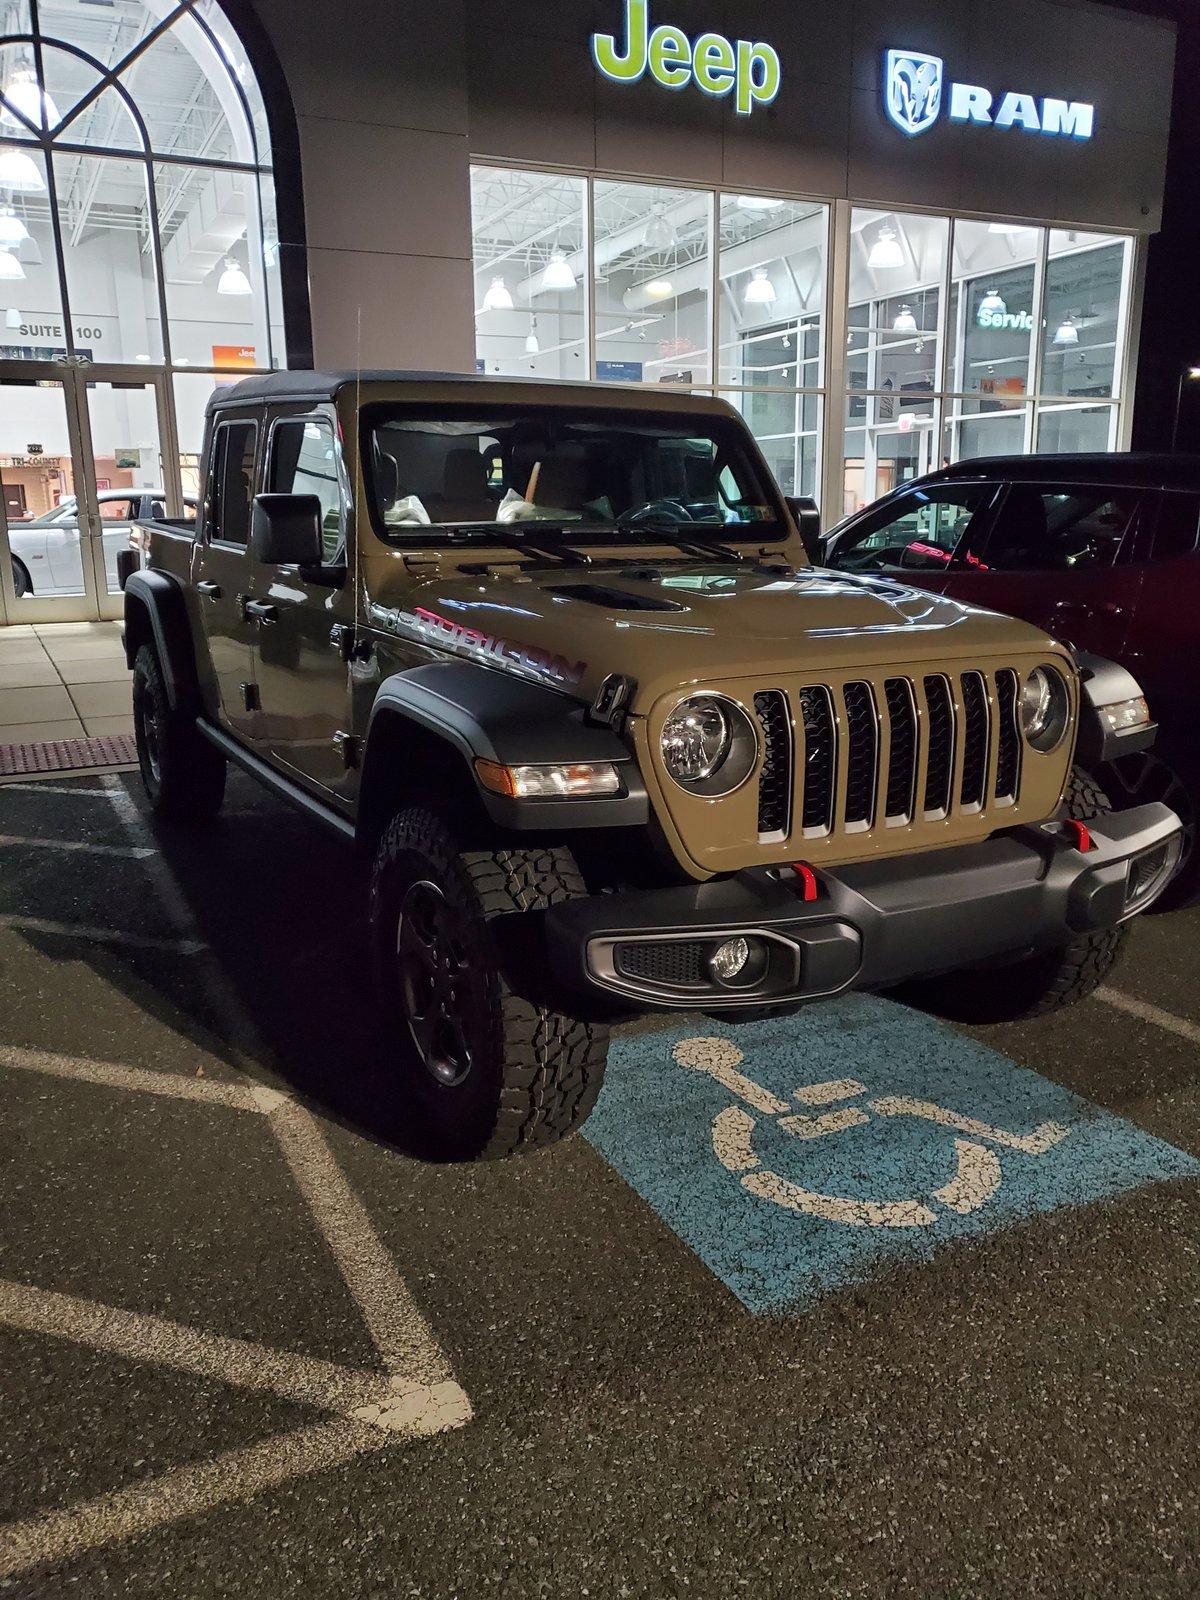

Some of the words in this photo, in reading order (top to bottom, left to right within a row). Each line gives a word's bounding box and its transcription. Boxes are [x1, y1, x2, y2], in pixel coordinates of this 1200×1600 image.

[593, 0, 780, 114] Jeep
[950, 82, 1094, 137] RAM
[19, 324, 62, 337] SUITE
[76, 327, 102, 339] 100
[979, 308, 1046, 329] Servic
